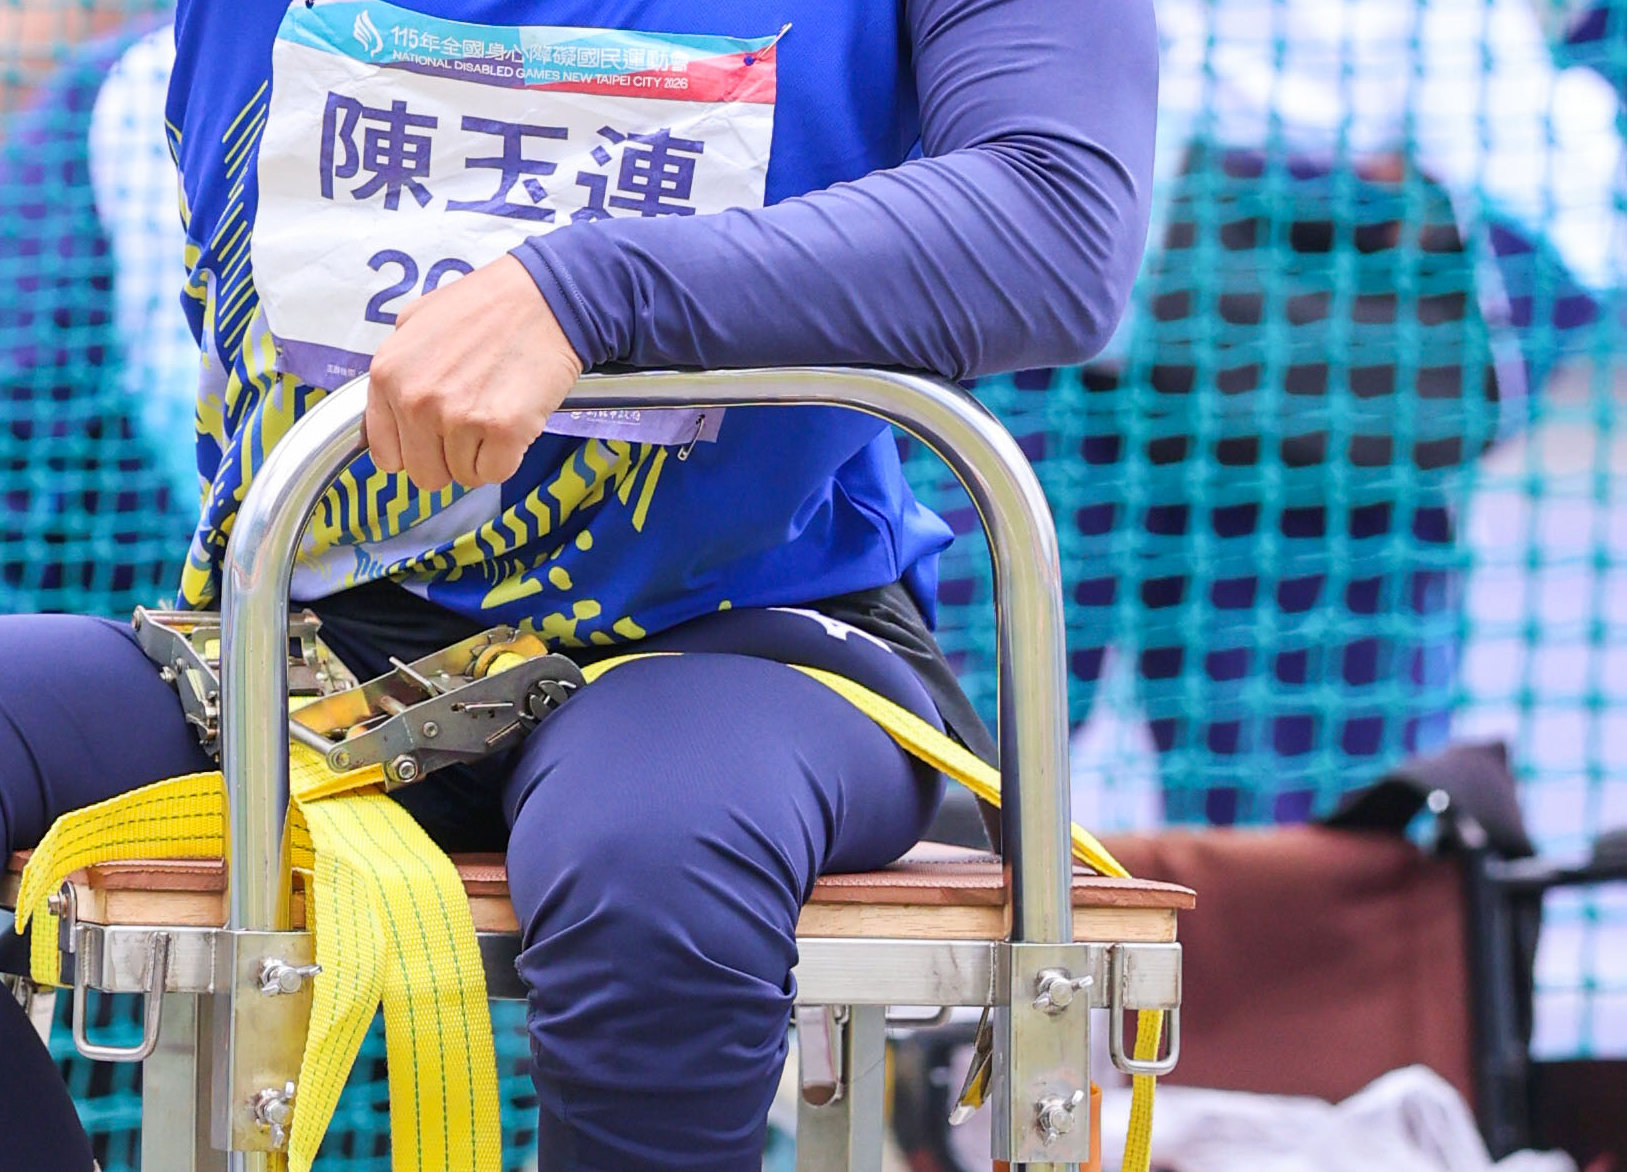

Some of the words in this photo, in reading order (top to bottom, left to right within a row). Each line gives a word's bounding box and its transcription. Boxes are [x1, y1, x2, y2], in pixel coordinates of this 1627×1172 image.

[392, 50, 452, 69] NATIONAL
[454, 61, 514, 78] DISABLED
[515, 68, 560, 81] GAMES
[562, 70, 595, 85] NEW
[595, 73, 631, 86] TAIPEI
[632, 75, 663, 89] CITY
[319, 90, 705, 223] 陳玉連
